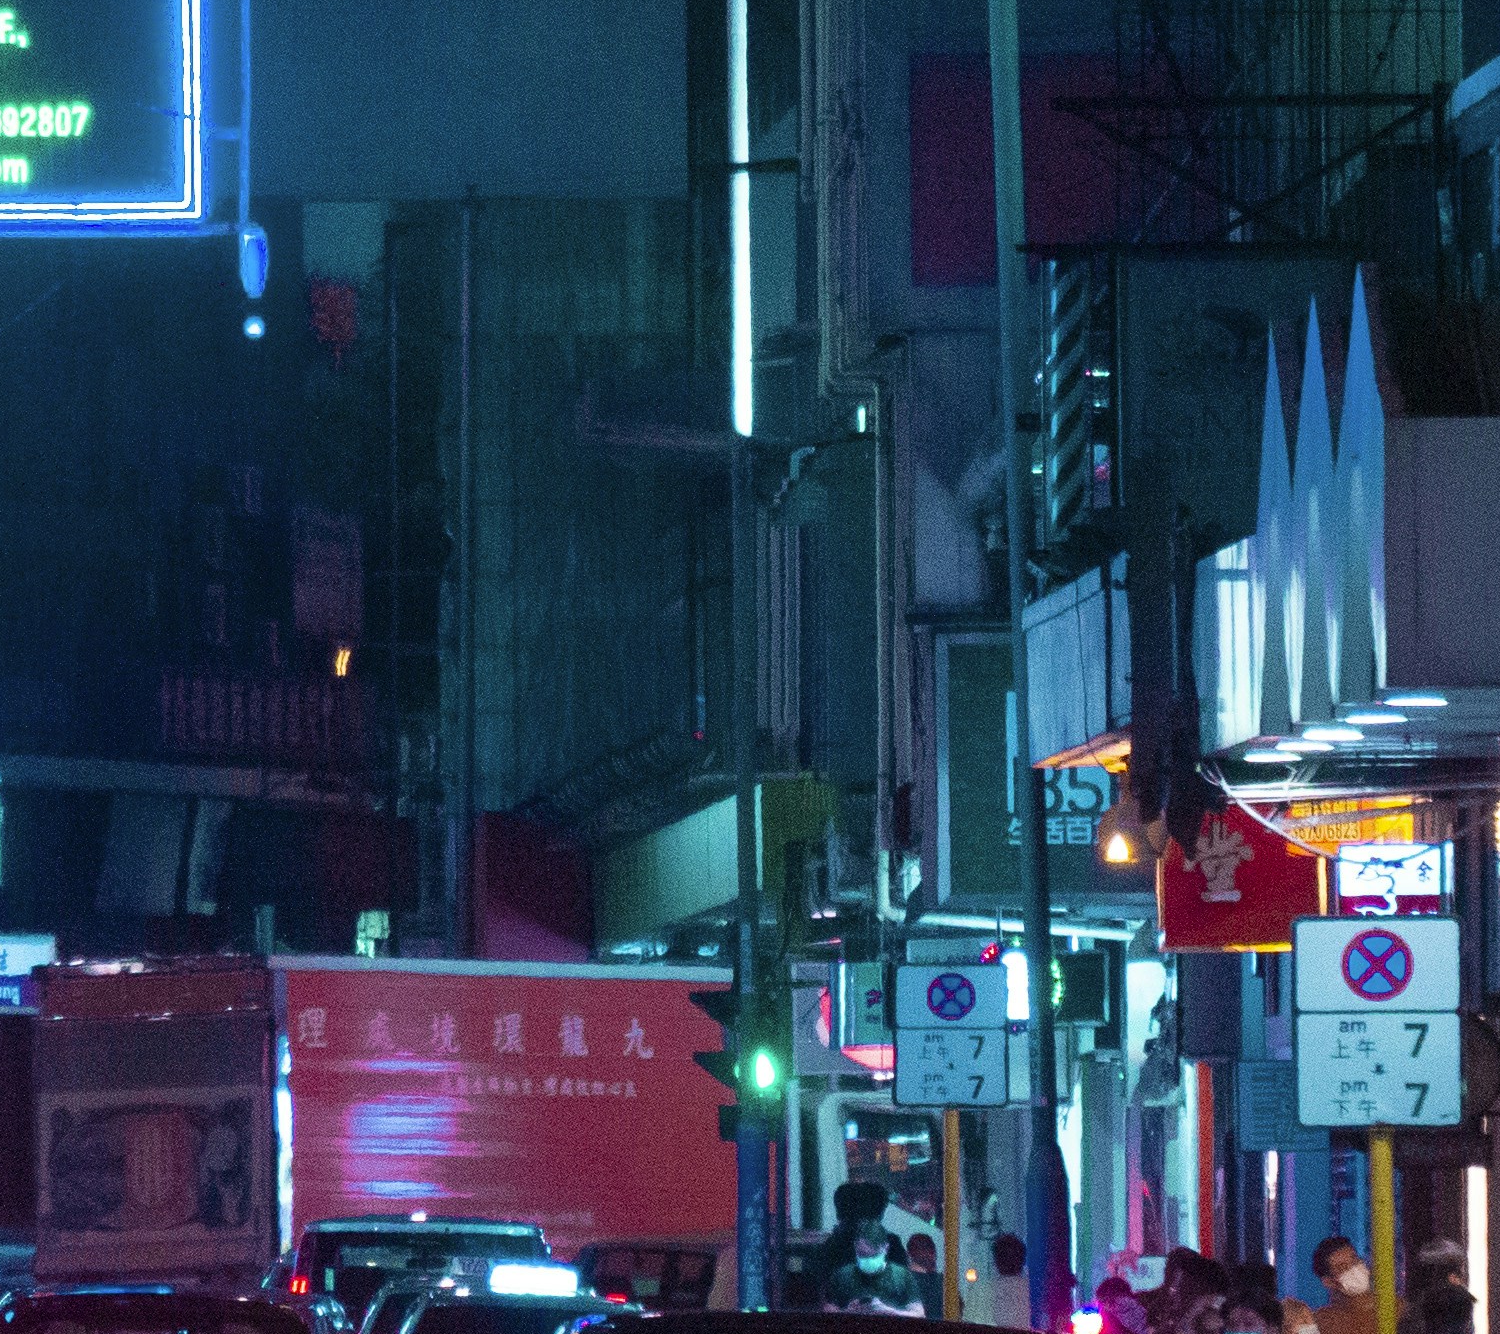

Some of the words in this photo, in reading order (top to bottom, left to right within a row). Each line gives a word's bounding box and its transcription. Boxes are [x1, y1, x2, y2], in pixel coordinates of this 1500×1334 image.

[969, 1035, 985, 1060] 7
[1330, 1039, 1376, 1059] 上午
[1339, 1020, 1367, 1033] am
[1404, 1023, 1429, 1059] 7
[968, 1074, 984, 1099] 7
[1340, 1080, 1369, 1094] pm
[1405, 1083, 1430, 1117] 7
[1331, 1099, 1378, 1118] 下午
